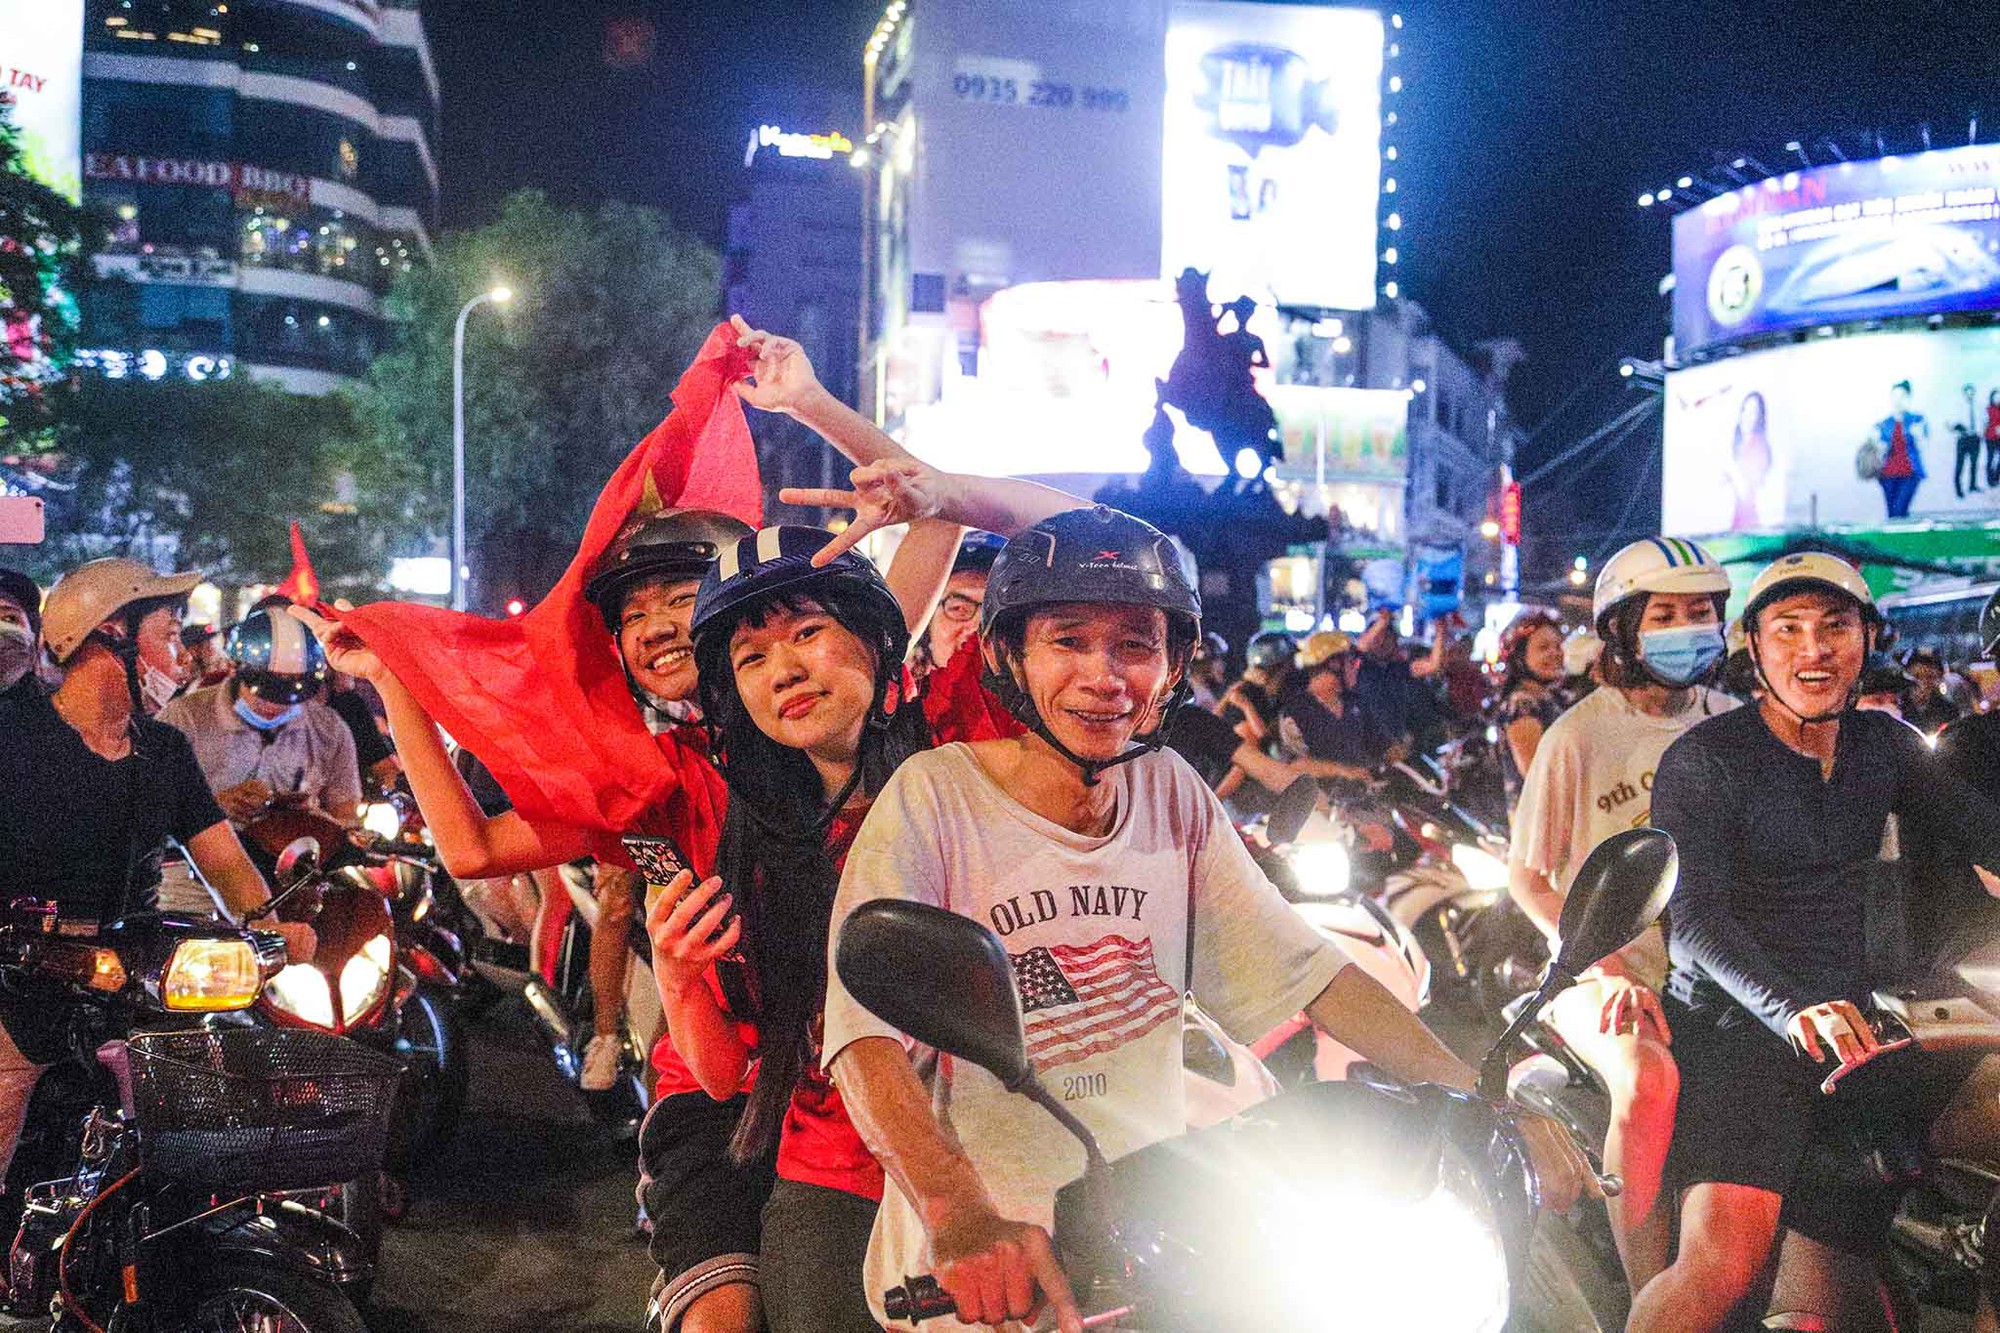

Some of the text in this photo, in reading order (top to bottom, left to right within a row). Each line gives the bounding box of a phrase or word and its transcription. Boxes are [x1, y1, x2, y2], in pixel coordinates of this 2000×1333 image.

[9, 68, 47, 93] TAY
[85, 153, 231, 186] EAFOOD
[1597, 782, 1639, 813] 9th
[989, 885, 1149, 936] OLD NAVY
[1063, 1073, 1107, 1101] 2010
